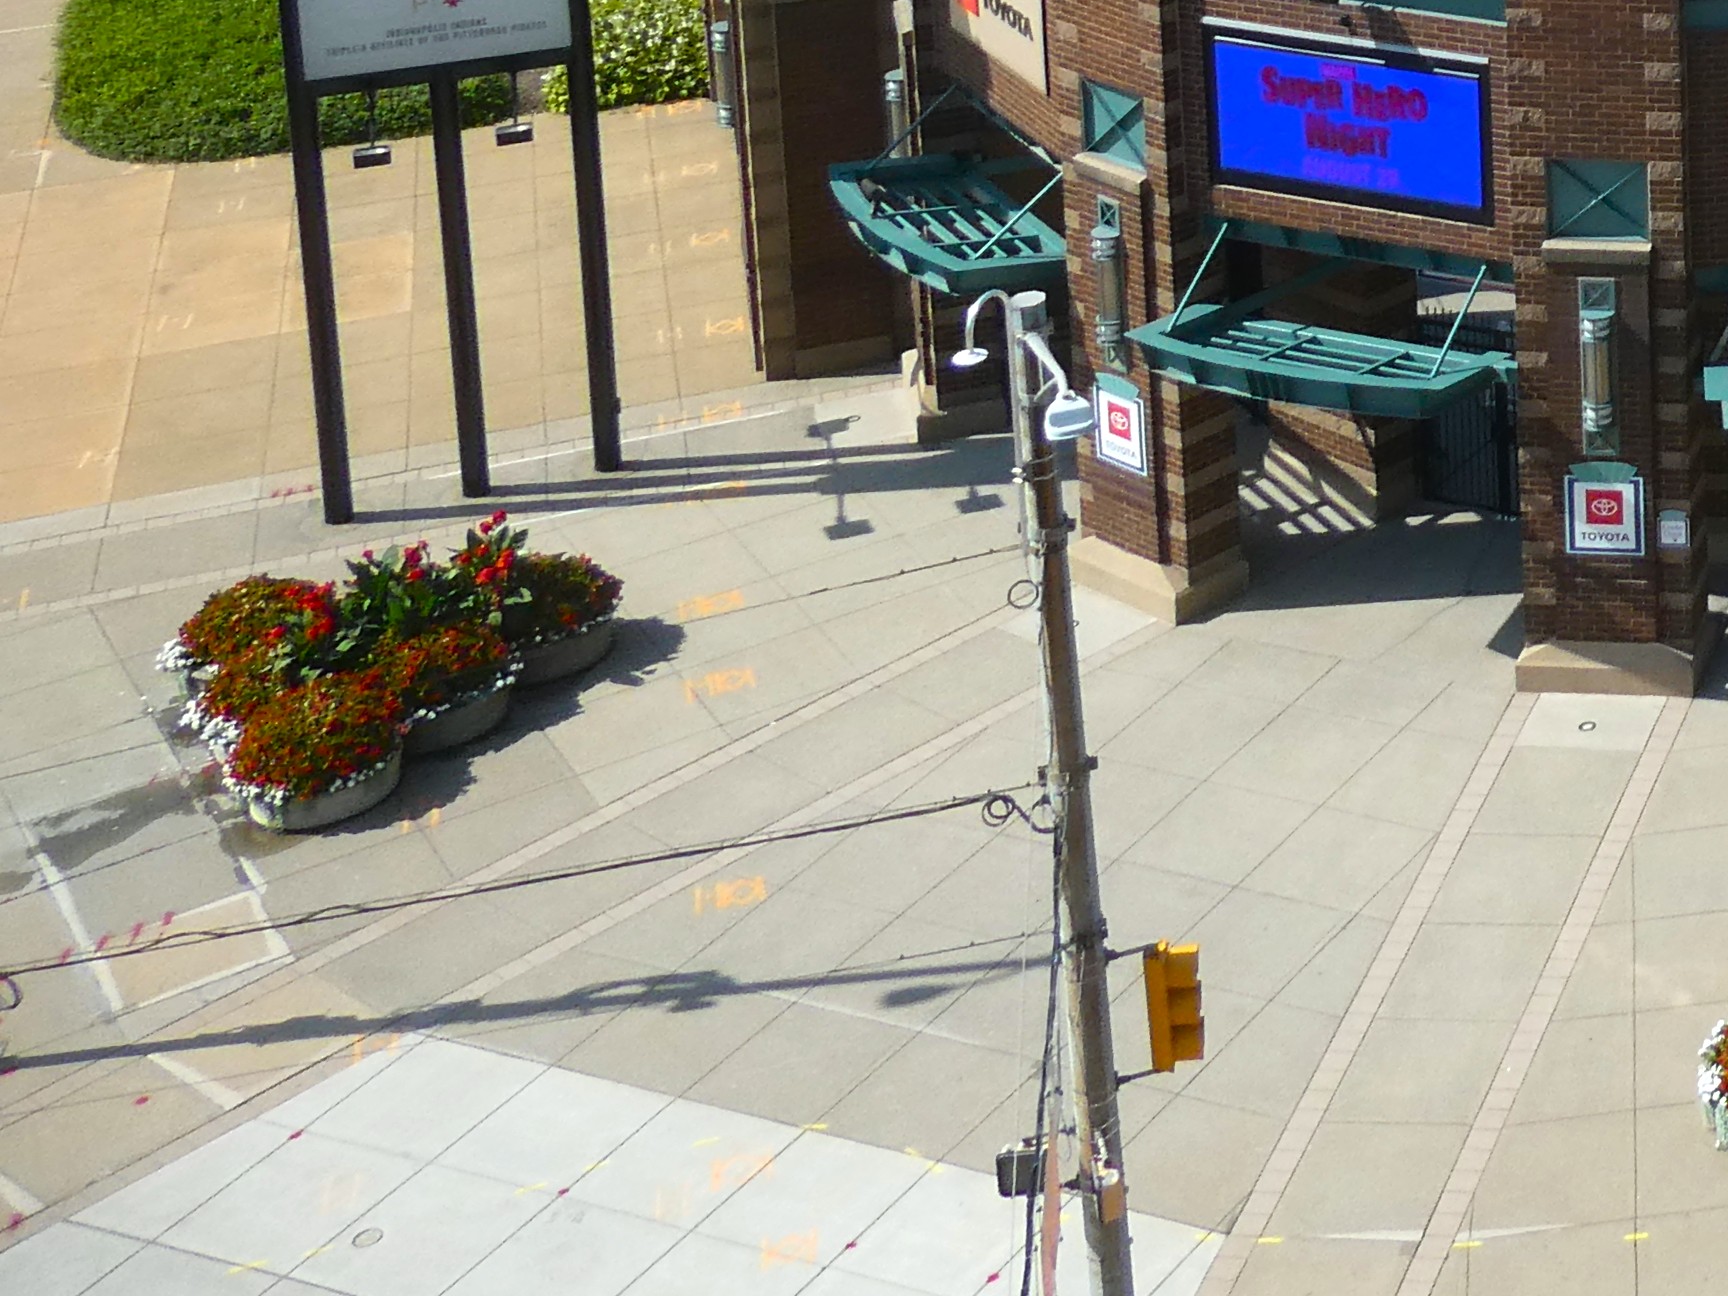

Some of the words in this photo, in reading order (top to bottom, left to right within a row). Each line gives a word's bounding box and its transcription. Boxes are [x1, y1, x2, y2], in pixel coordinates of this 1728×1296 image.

[1260, 65, 1343, 110] SUPER
[1352, 80, 1428, 122] HERO
[1304, 112, 1391, 159] NIGHT
[1105, 439, 1137, 460] TOYOTA
[1580, 531, 1631, 542] TOYOTA
